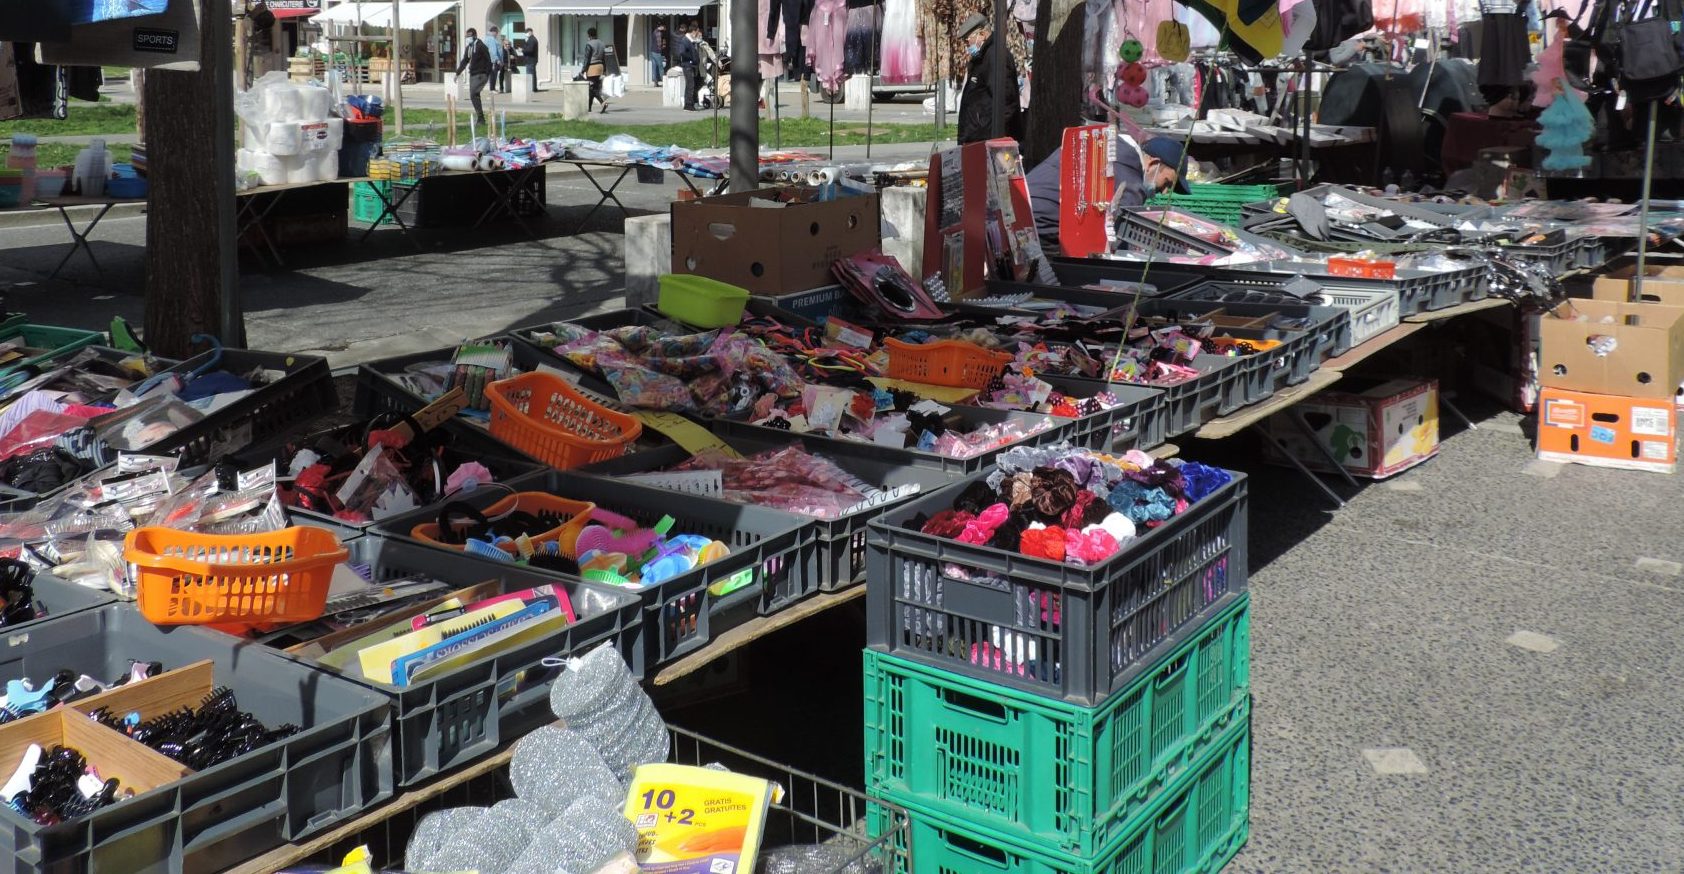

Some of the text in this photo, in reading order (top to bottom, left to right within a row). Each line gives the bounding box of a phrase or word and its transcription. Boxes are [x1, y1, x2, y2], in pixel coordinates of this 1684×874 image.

[137, 34, 174, 45] SPORTS
[792, 292, 832, 309] PREMIUM
[642, 788, 676, 810] 10
[704, 797, 732, 807] GRATIS
[704, 804, 747, 814] GRATUITES
[664, 808, 695, 826] +2
